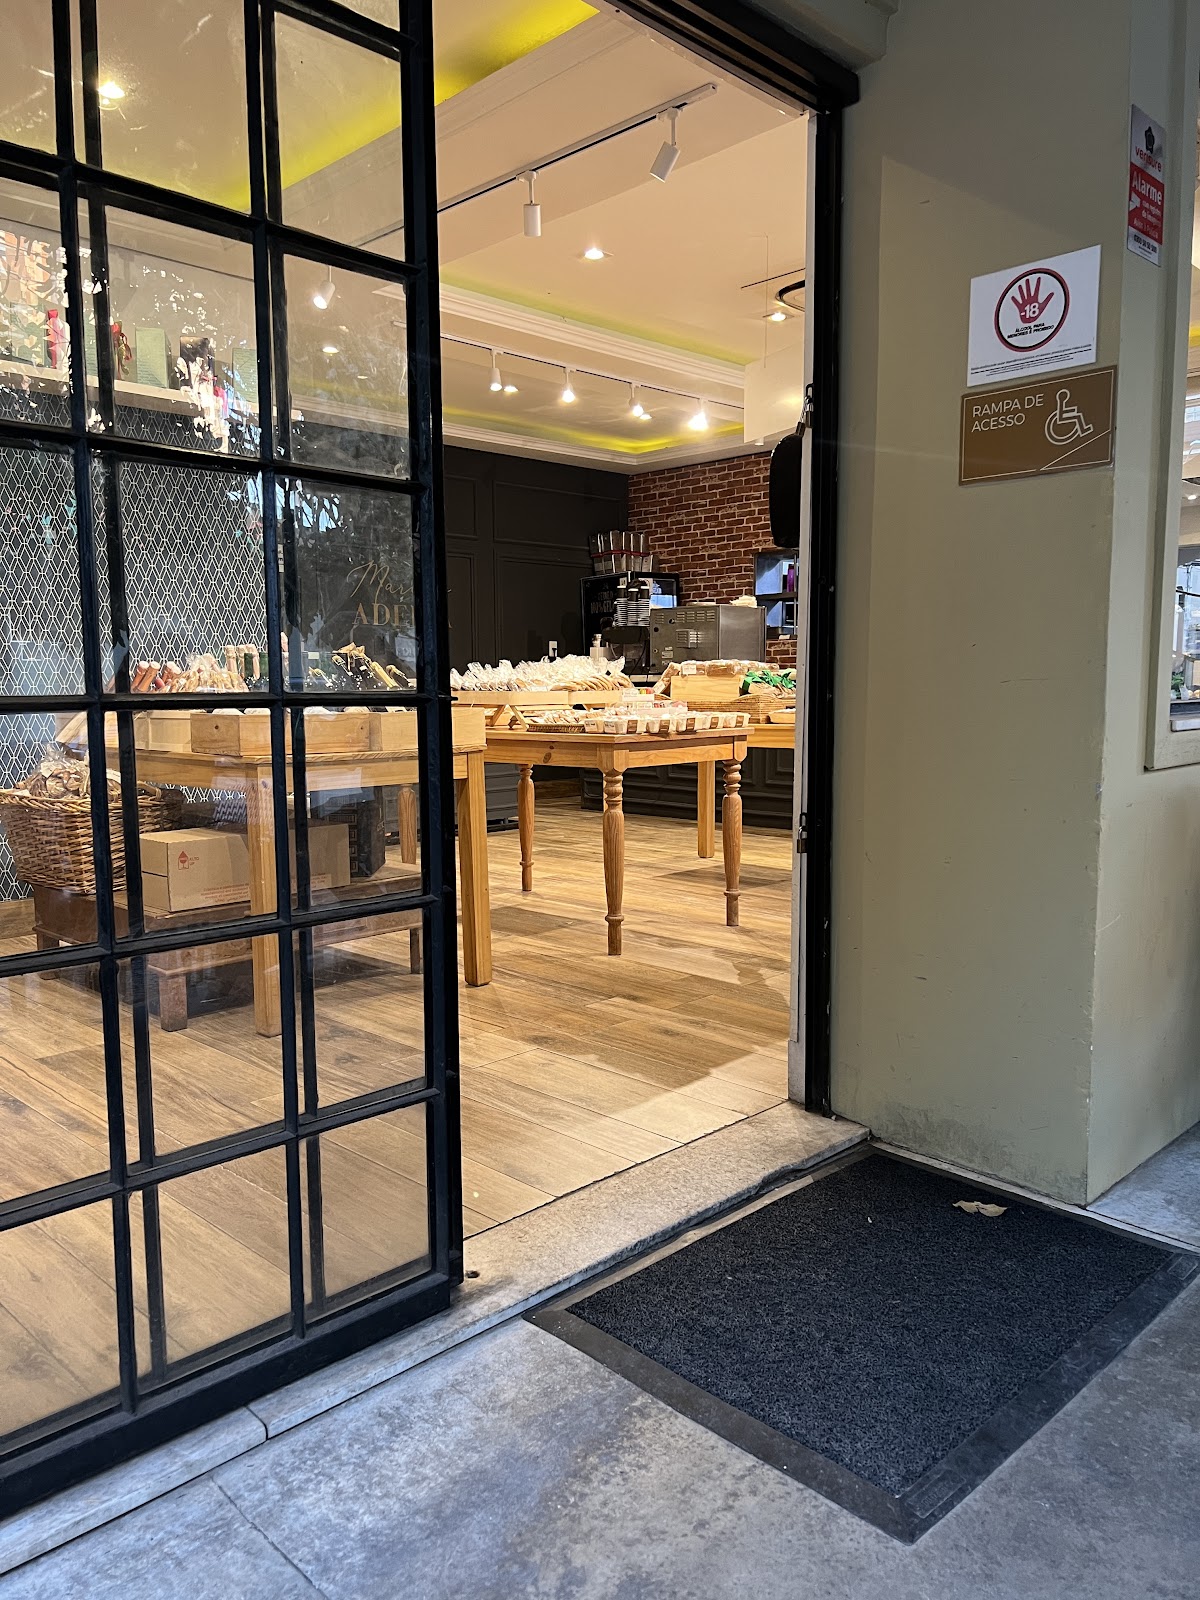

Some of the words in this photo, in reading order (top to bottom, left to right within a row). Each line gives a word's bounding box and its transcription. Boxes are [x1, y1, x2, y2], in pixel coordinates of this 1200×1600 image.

[1132, 171, 1162, 206] Alarme
[1020, 302, 1039, 318] -18
[972, 398, 1021, 418] RAMPA
[1024, 393, 1044, 409] DE
[971, 412, 1026, 433] ACESSO
[346, 559, 414, 604] Mar
[351, 602, 415, 626] ADE
